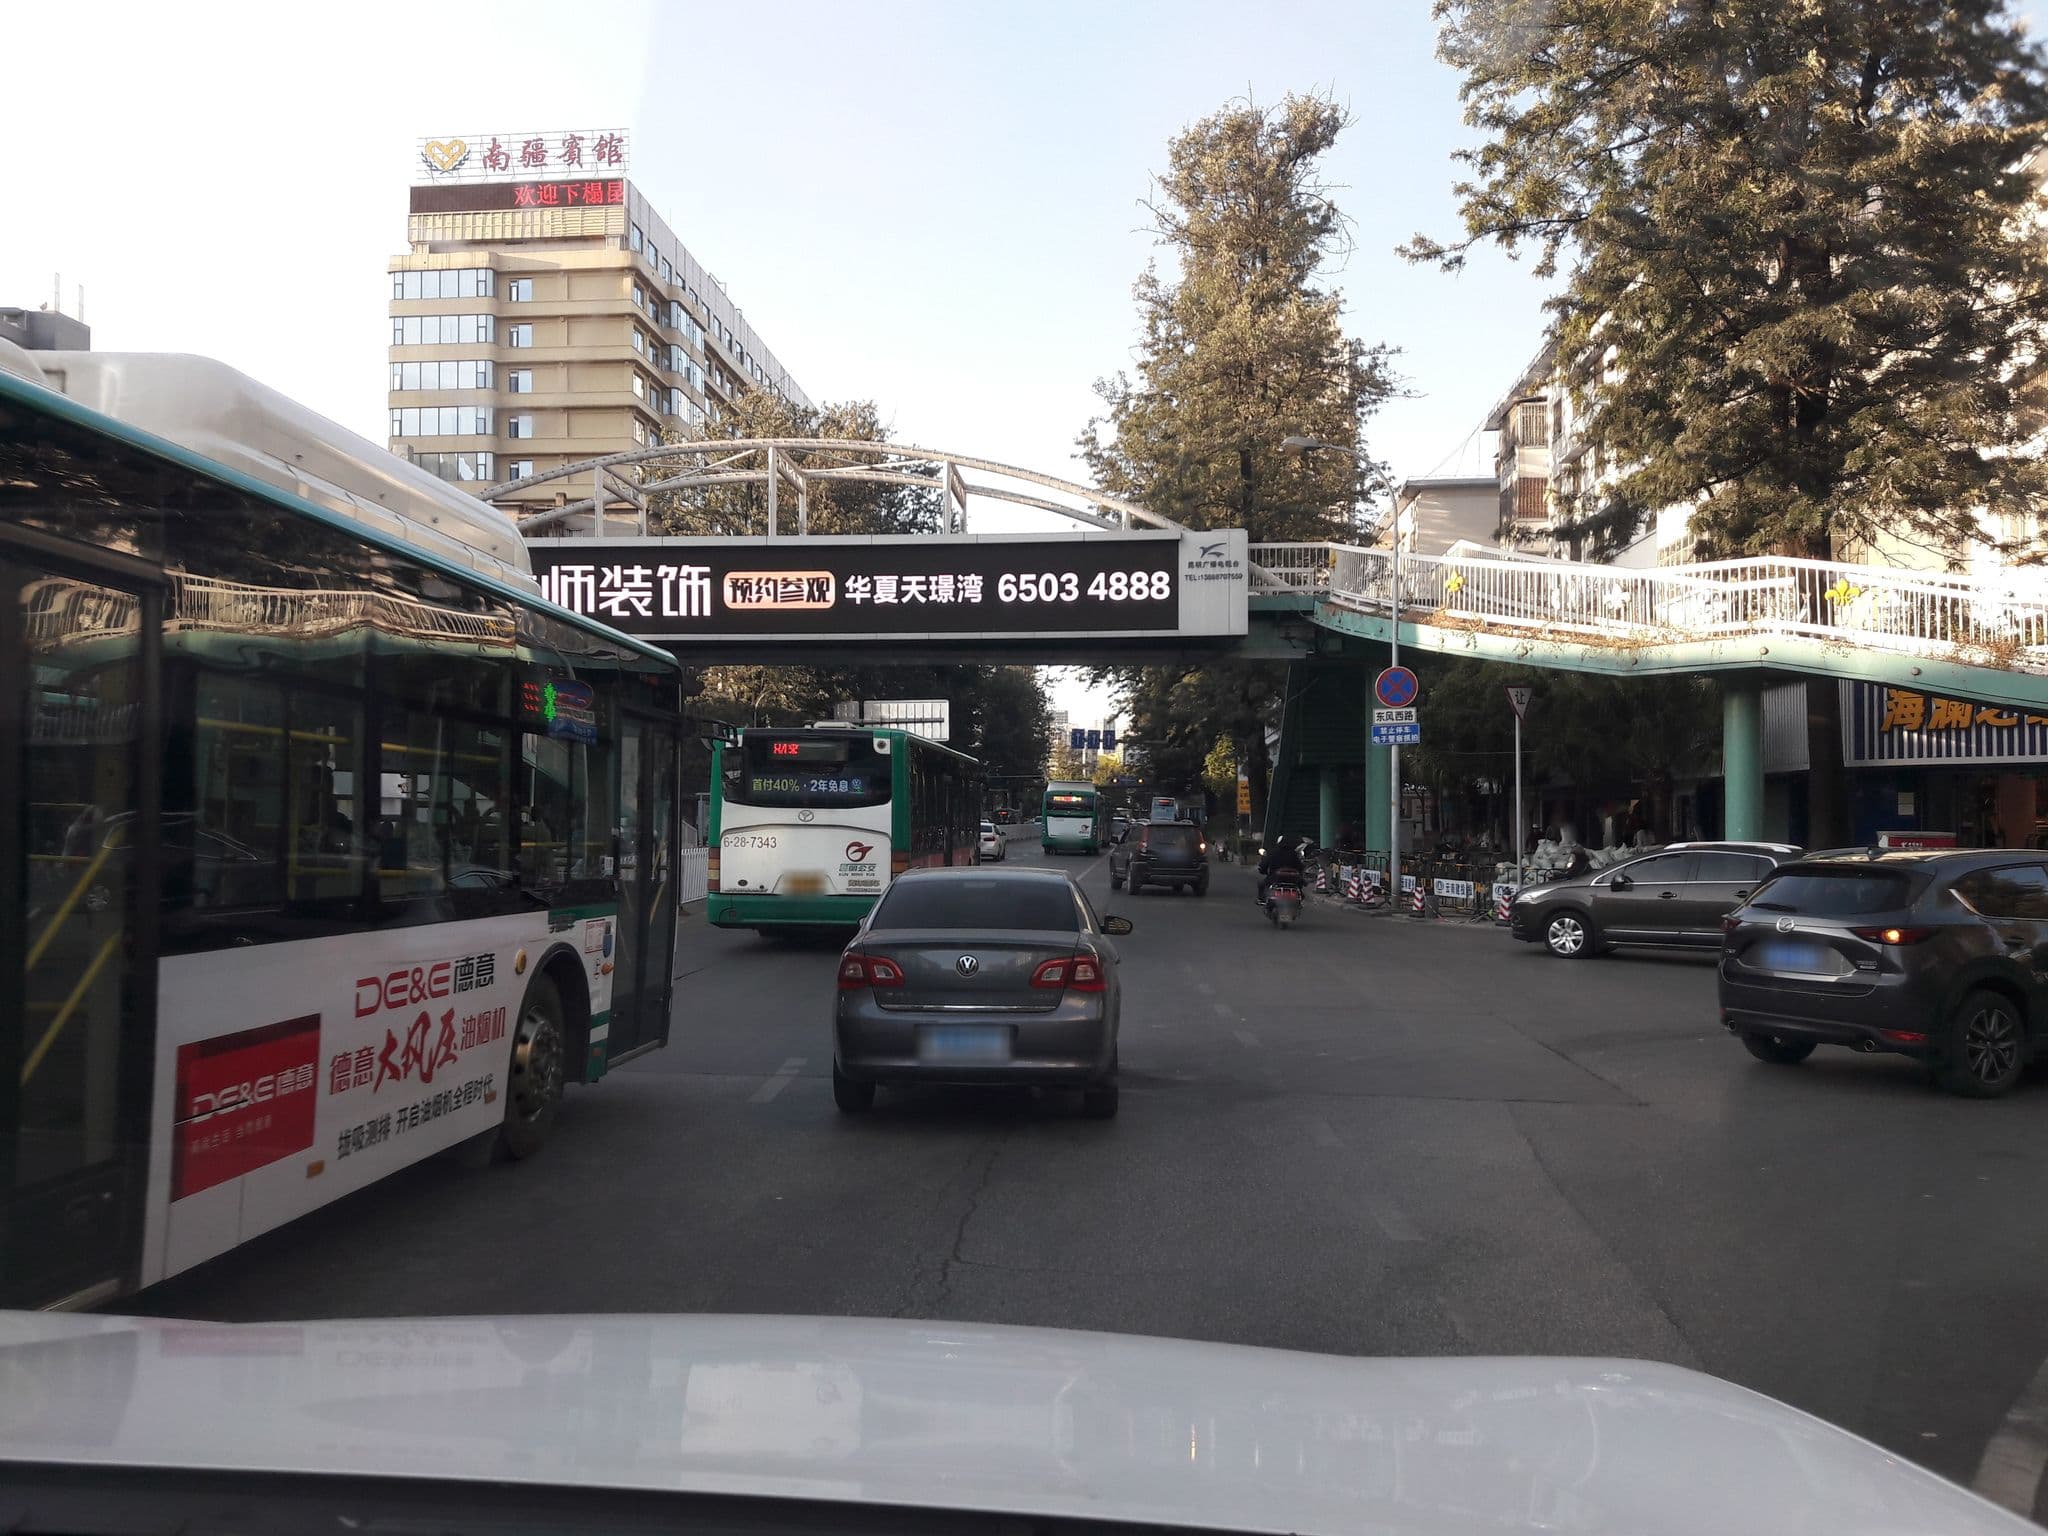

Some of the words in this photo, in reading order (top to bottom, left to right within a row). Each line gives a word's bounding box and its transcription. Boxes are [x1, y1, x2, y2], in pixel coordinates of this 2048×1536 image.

[540, 564, 712, 618] 师装饰
[727, 575, 831, 604] 预约参观
[844, 574, 984, 605] 华夏天璟湾
[997, 571, 1080, 603] 6503
[1087, 571, 1171, 601] 4888
[1514, 690, 1526, 705] 让
[1375, 710, 1414, 722] 东风西路
[723, 836, 777, 849] 6-28-7343
